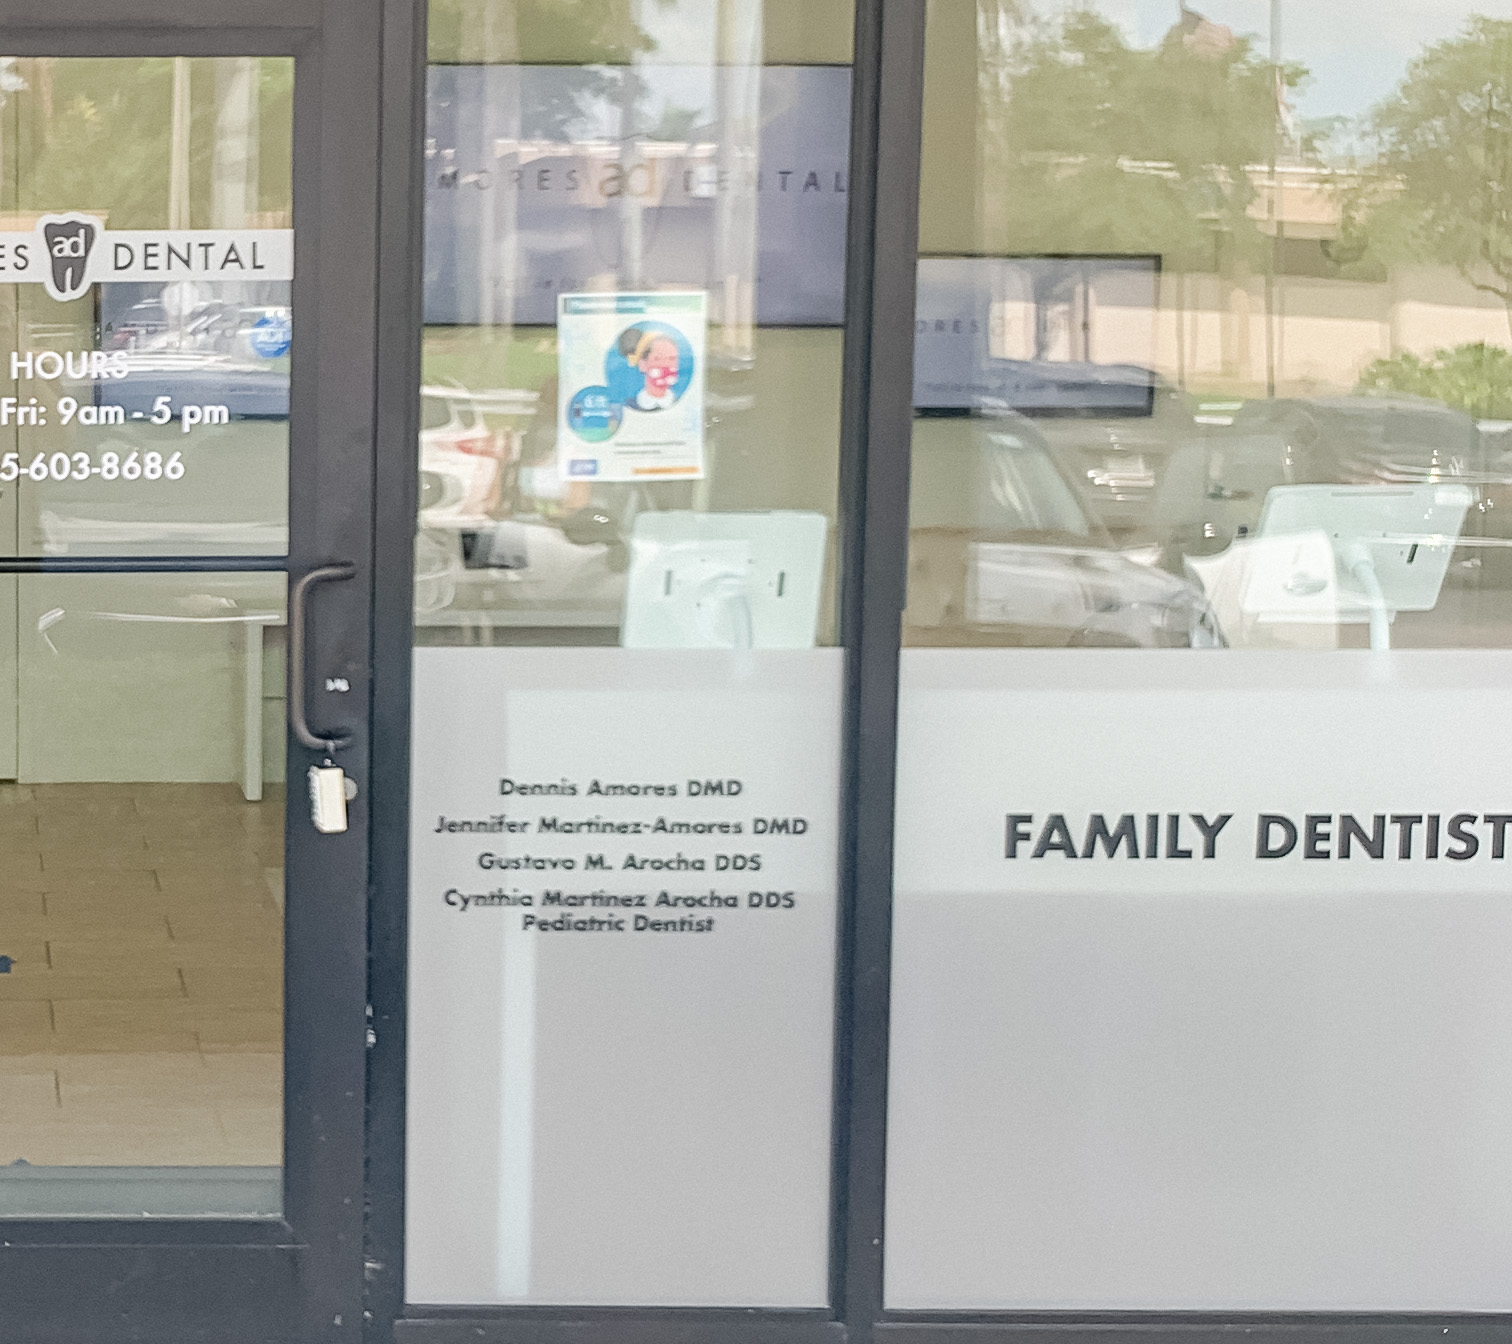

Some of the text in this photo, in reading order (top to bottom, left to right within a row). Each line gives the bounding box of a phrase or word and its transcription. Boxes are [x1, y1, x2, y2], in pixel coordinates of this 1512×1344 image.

[51, 227, 86, 258] ad
[113, 242, 266, 272] DENTAL
[10, 351, 131, 380] HOURS
[0, 397, 48, 426] Fri:
[57, 397, 126, 426] 9am
[150, 396, 172, 425] 5
[181, 404, 230, 433] pm
[499, 778, 743, 797] Dennis Amores DMD
[433, 814, 809, 835] Jennifer Martinez-Amores DMD
[1004, 812, 1512, 861] FAMILY DENTIST
[478, 852, 762, 872] Gustavo M. Arocha DDS
[444, 888, 796, 912] Cynthia Martinez Arocha DDS
[522, 913, 715, 933] Pediatric Dentist
